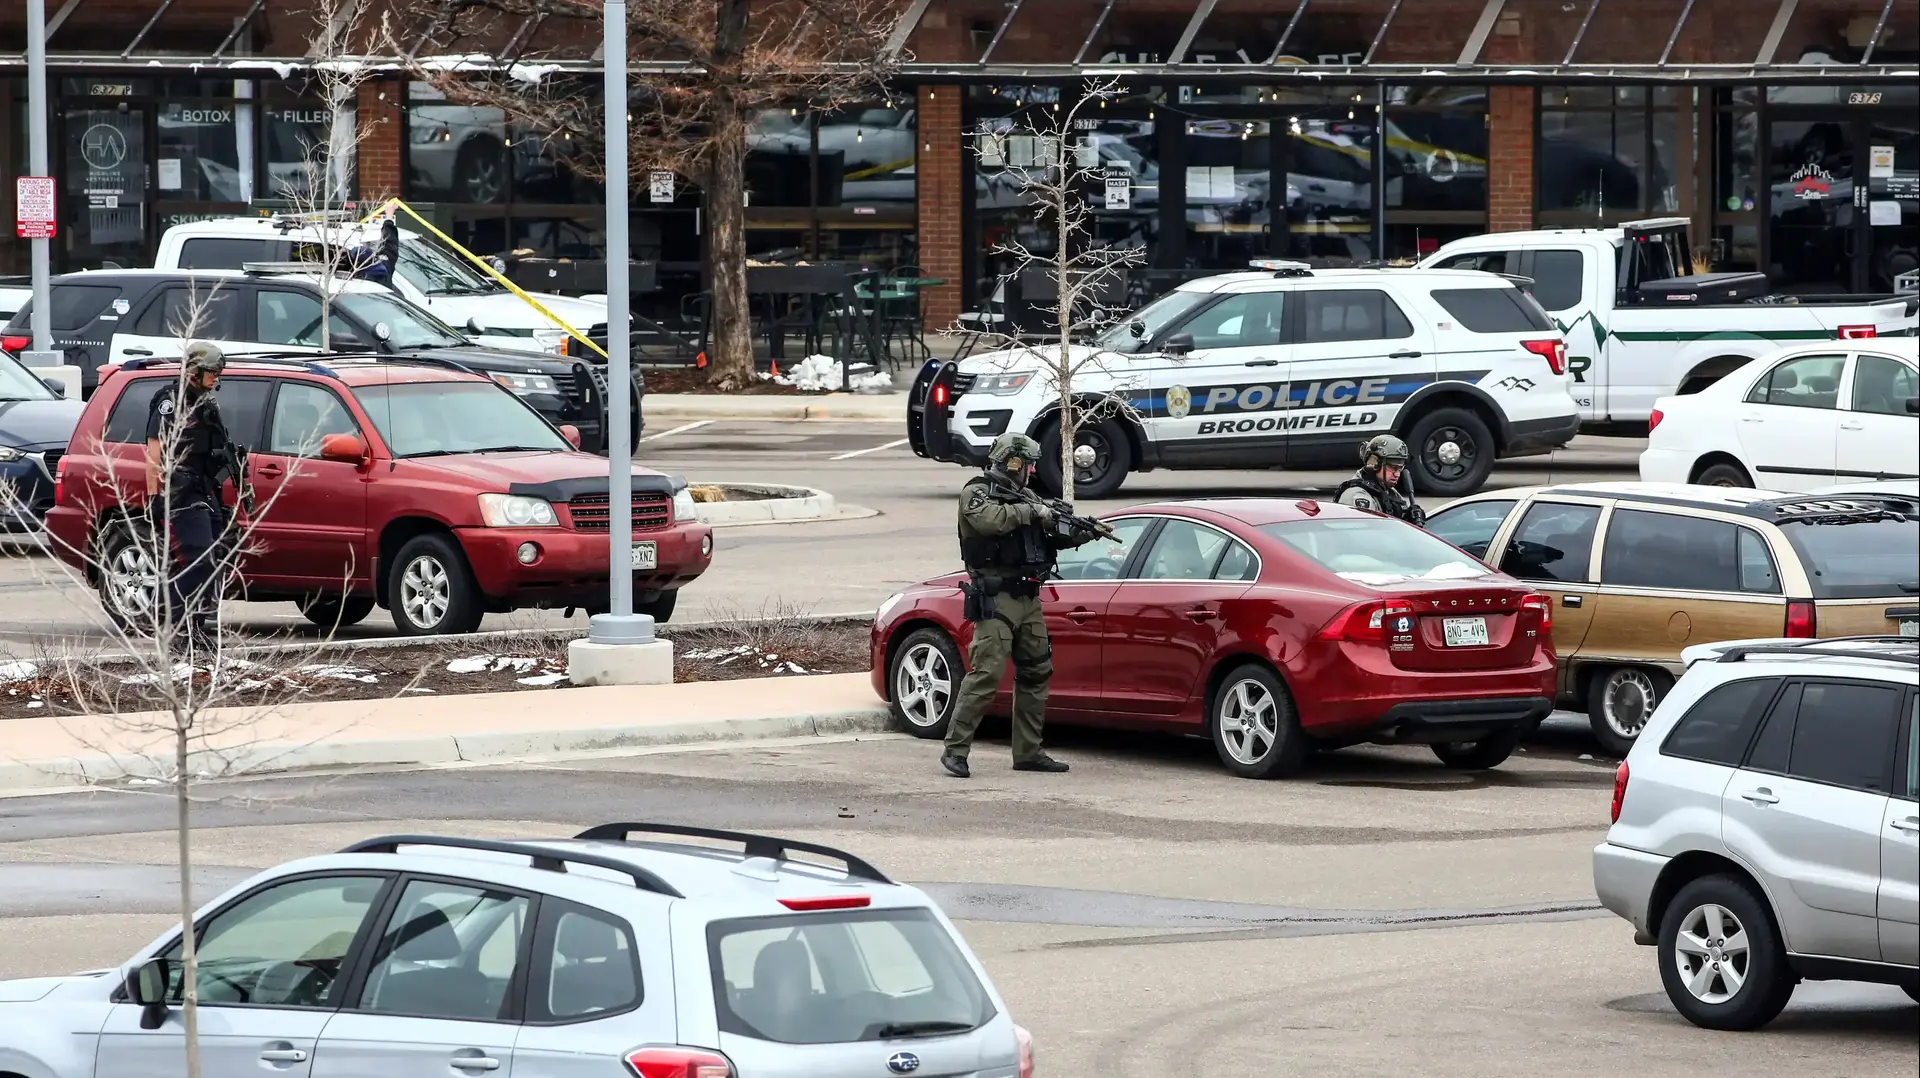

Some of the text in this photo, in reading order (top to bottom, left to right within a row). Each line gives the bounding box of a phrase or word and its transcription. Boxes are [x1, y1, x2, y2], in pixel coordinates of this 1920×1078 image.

[92, 85, 115, 95] 637
[1850, 93, 1880, 103] 637S
[182, 110, 231, 122] BOTOX
[1075, 119, 1096, 129] 637R
[1203, 377, 1390, 412] POLICE
[1197, 412, 1378, 435] BROOMFIELD
[1431, 598, 1507, 607] VOLVO
